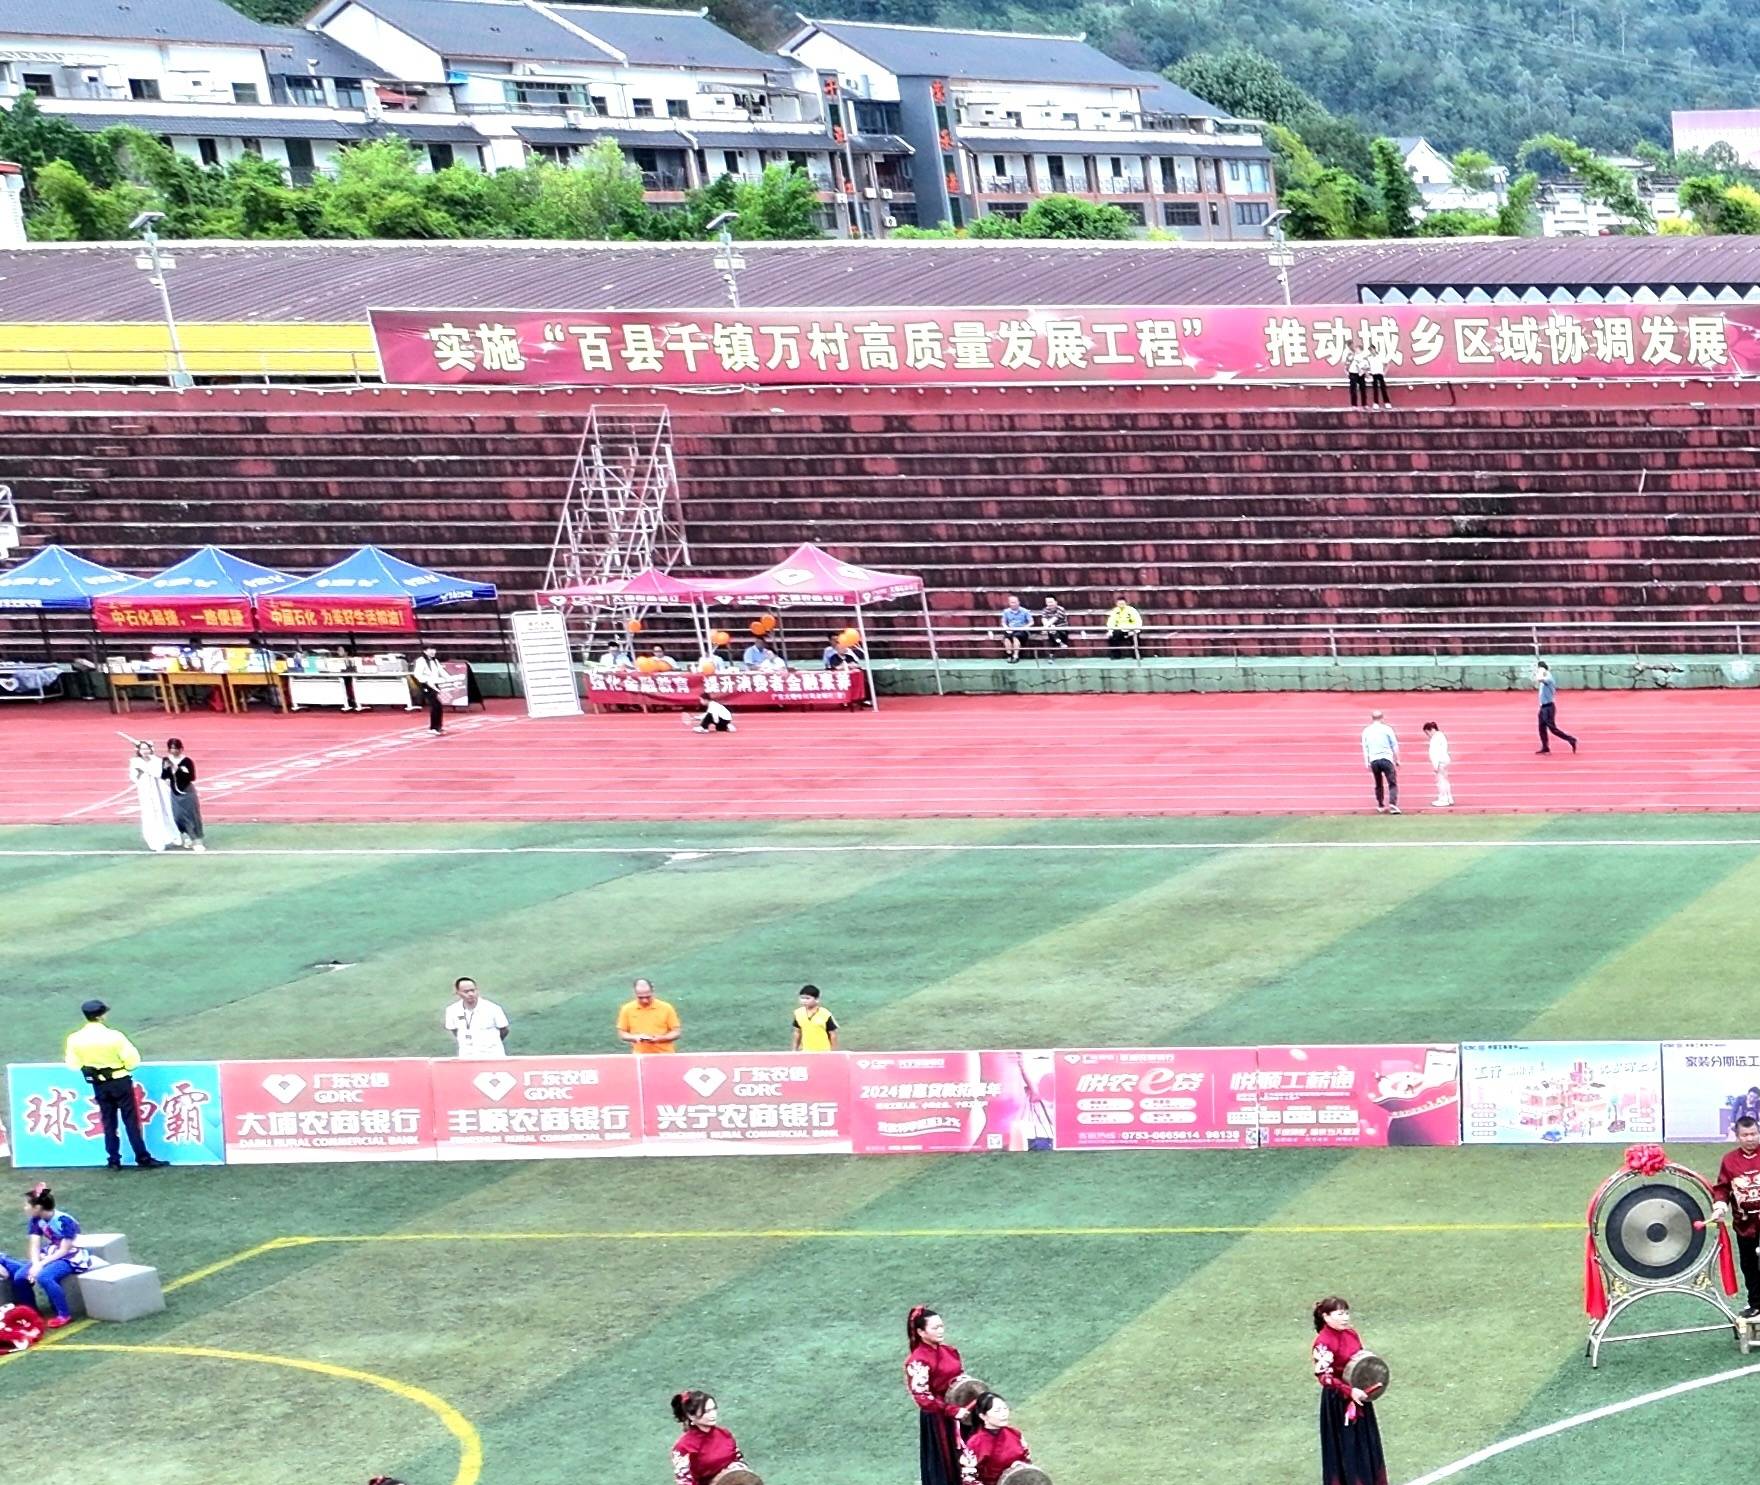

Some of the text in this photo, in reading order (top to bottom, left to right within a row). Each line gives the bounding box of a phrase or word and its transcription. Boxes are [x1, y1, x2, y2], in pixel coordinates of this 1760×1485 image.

[1263, 313, 1730, 367] 推动城乡区域协调发展
[313, 1072, 390, 1089] 广东农信
[523, 1069, 599, 1087] 广东农信
[733, 1066, 809, 1083] 广东农信
[313, 1090, 365, 1103] GDRC
[523, 1087, 574, 1101] GDRC
[733, 1083, 784, 1097] GDRC
[27, 1082, 209, 1143] 球霸
[447, 1105, 630, 1134] 丰顺农商银行
[656, 1102, 840, 1130] 兴宁农商银行
[236, 1108, 422, 1136] 大埔农商银行
